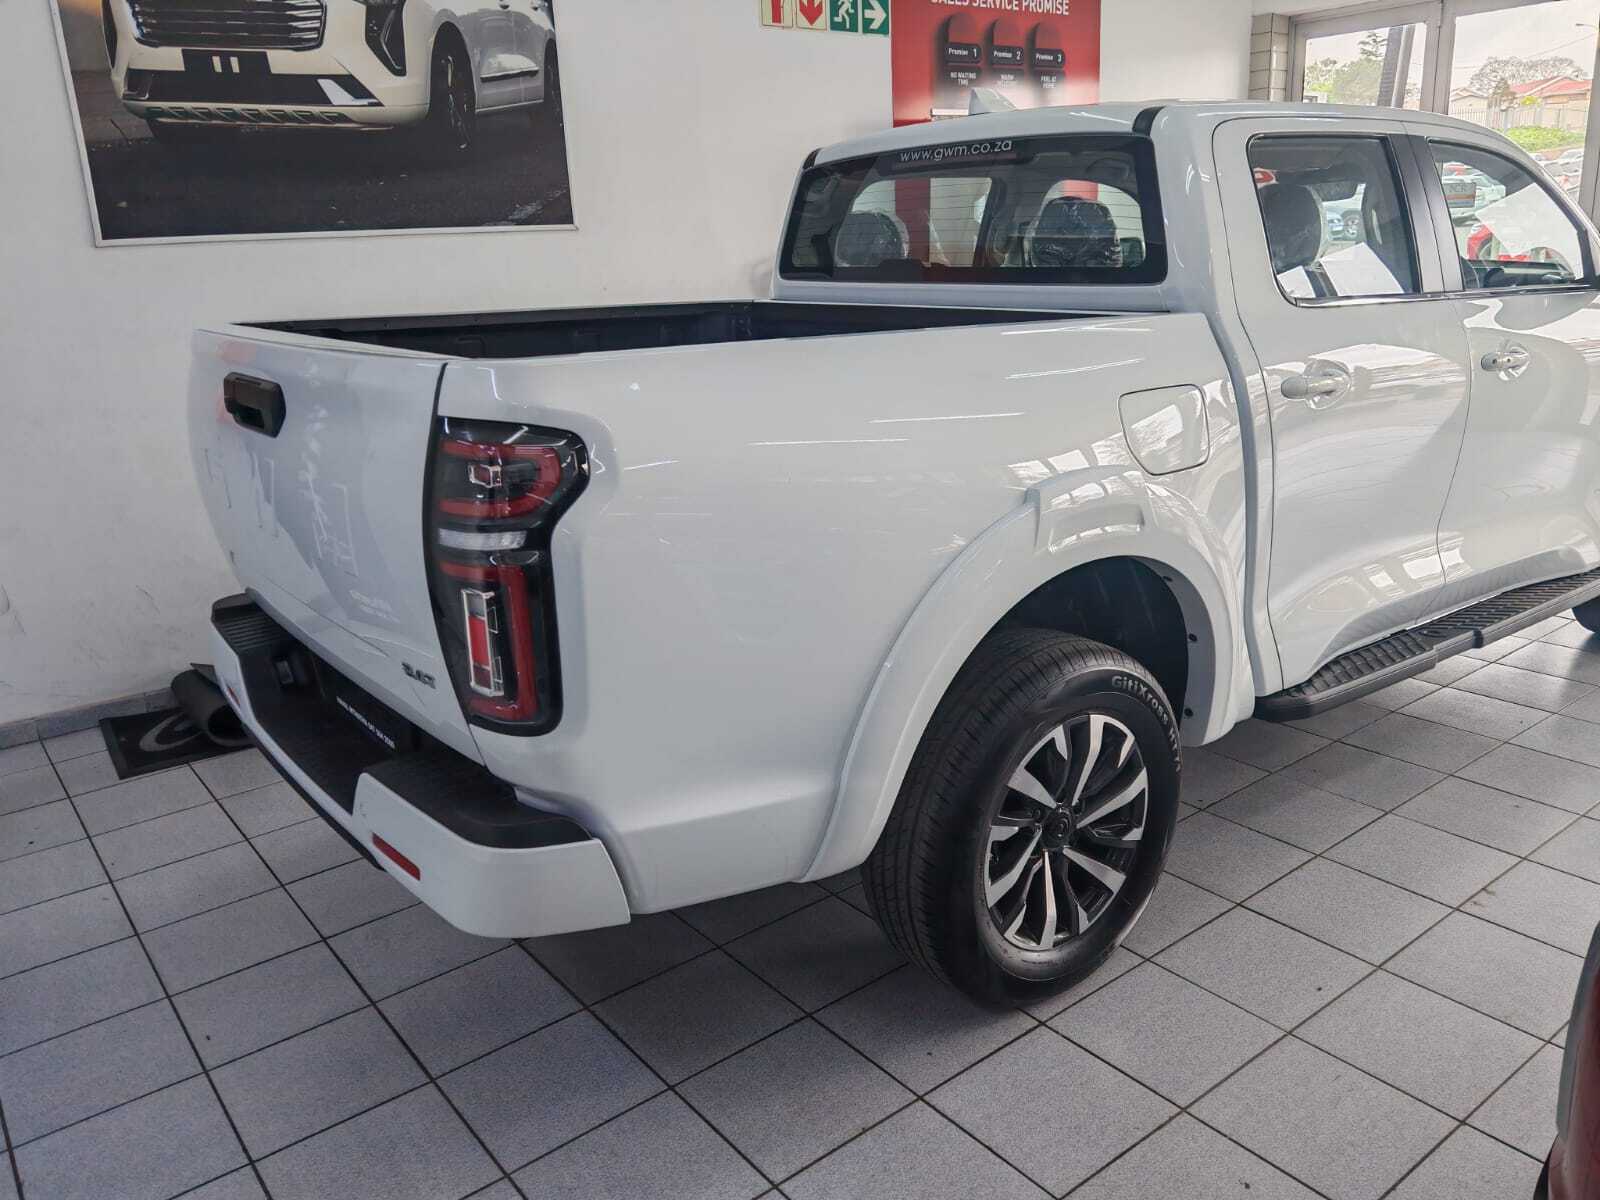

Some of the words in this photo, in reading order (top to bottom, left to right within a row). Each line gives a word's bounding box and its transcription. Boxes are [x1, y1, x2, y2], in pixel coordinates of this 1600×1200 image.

[1022, 0, 1069, 15] PROMISE
[948, 47, 969, 55] Promise
[993, 50, 1012, 58] Promise
[1035, 53, 1053, 61] Promise
[900, 140, 1012, 161] www.gwm.co.za
